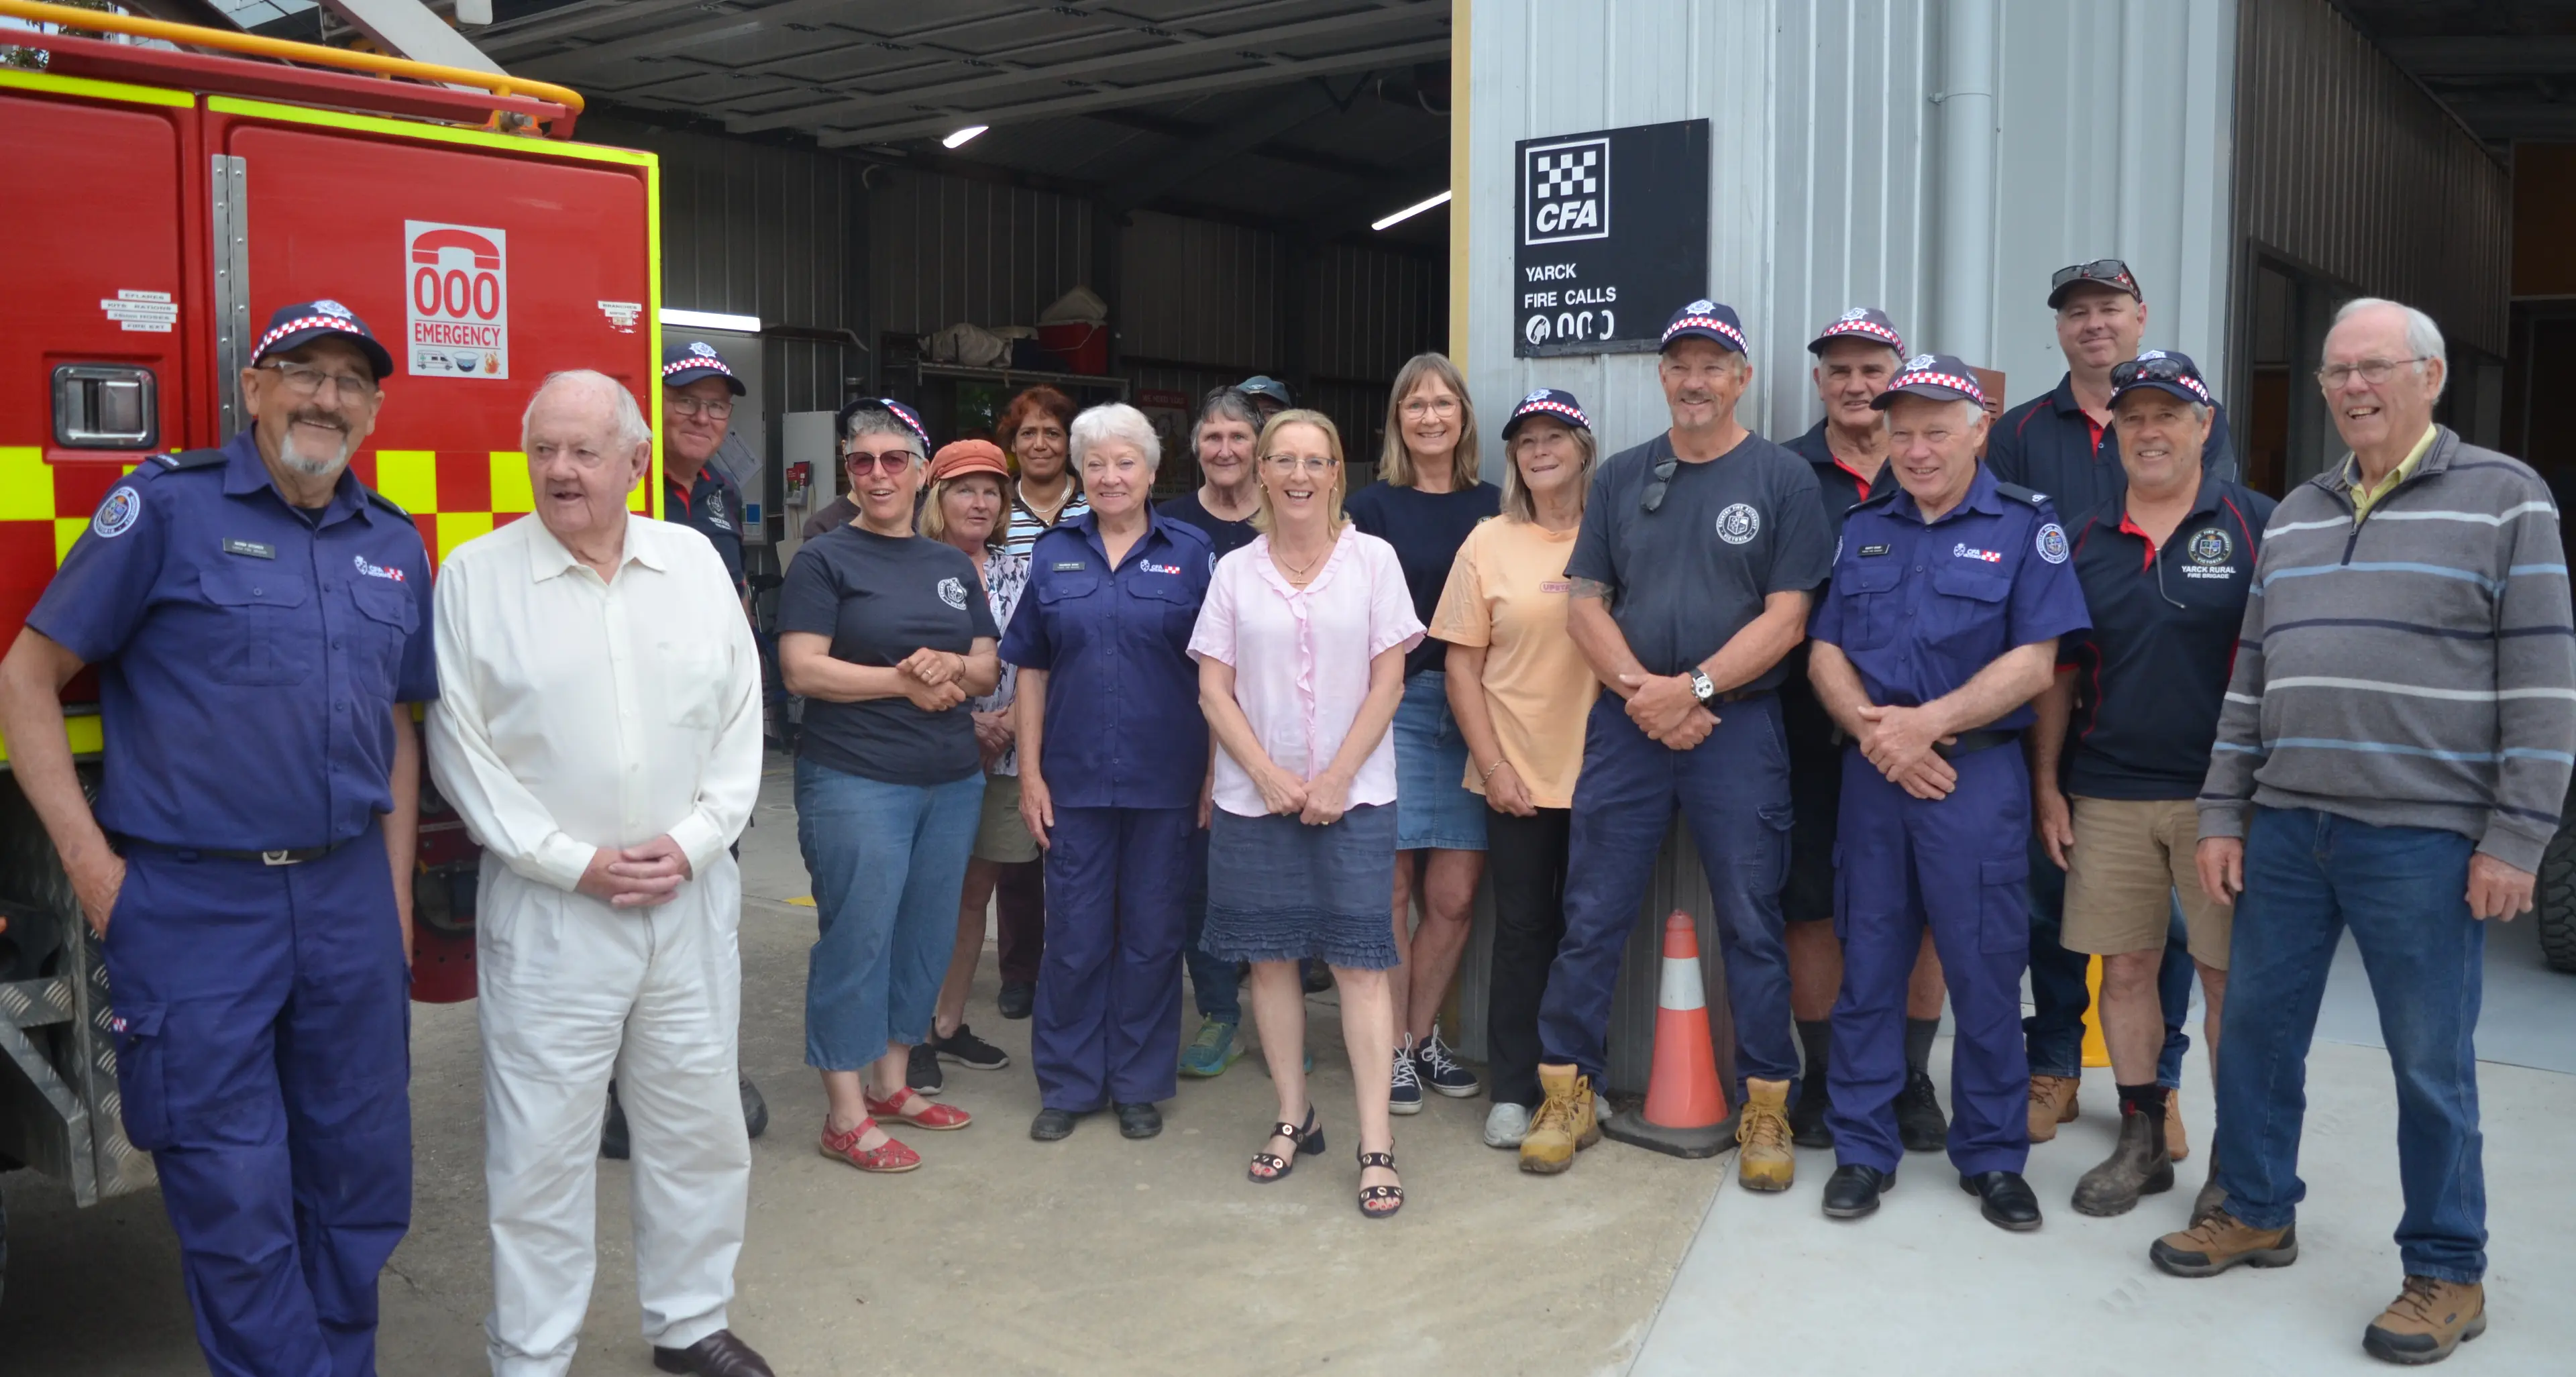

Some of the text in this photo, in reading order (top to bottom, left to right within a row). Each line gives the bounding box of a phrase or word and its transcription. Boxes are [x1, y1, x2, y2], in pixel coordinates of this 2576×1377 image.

[1536, 199, 1597, 233] CFA
[1525, 263, 1577, 282] YARCK
[414, 266, 500, 321] 000
[1524, 286, 1617, 309] FIRE CALLS
[415, 322, 500, 347] EMERGENCY
